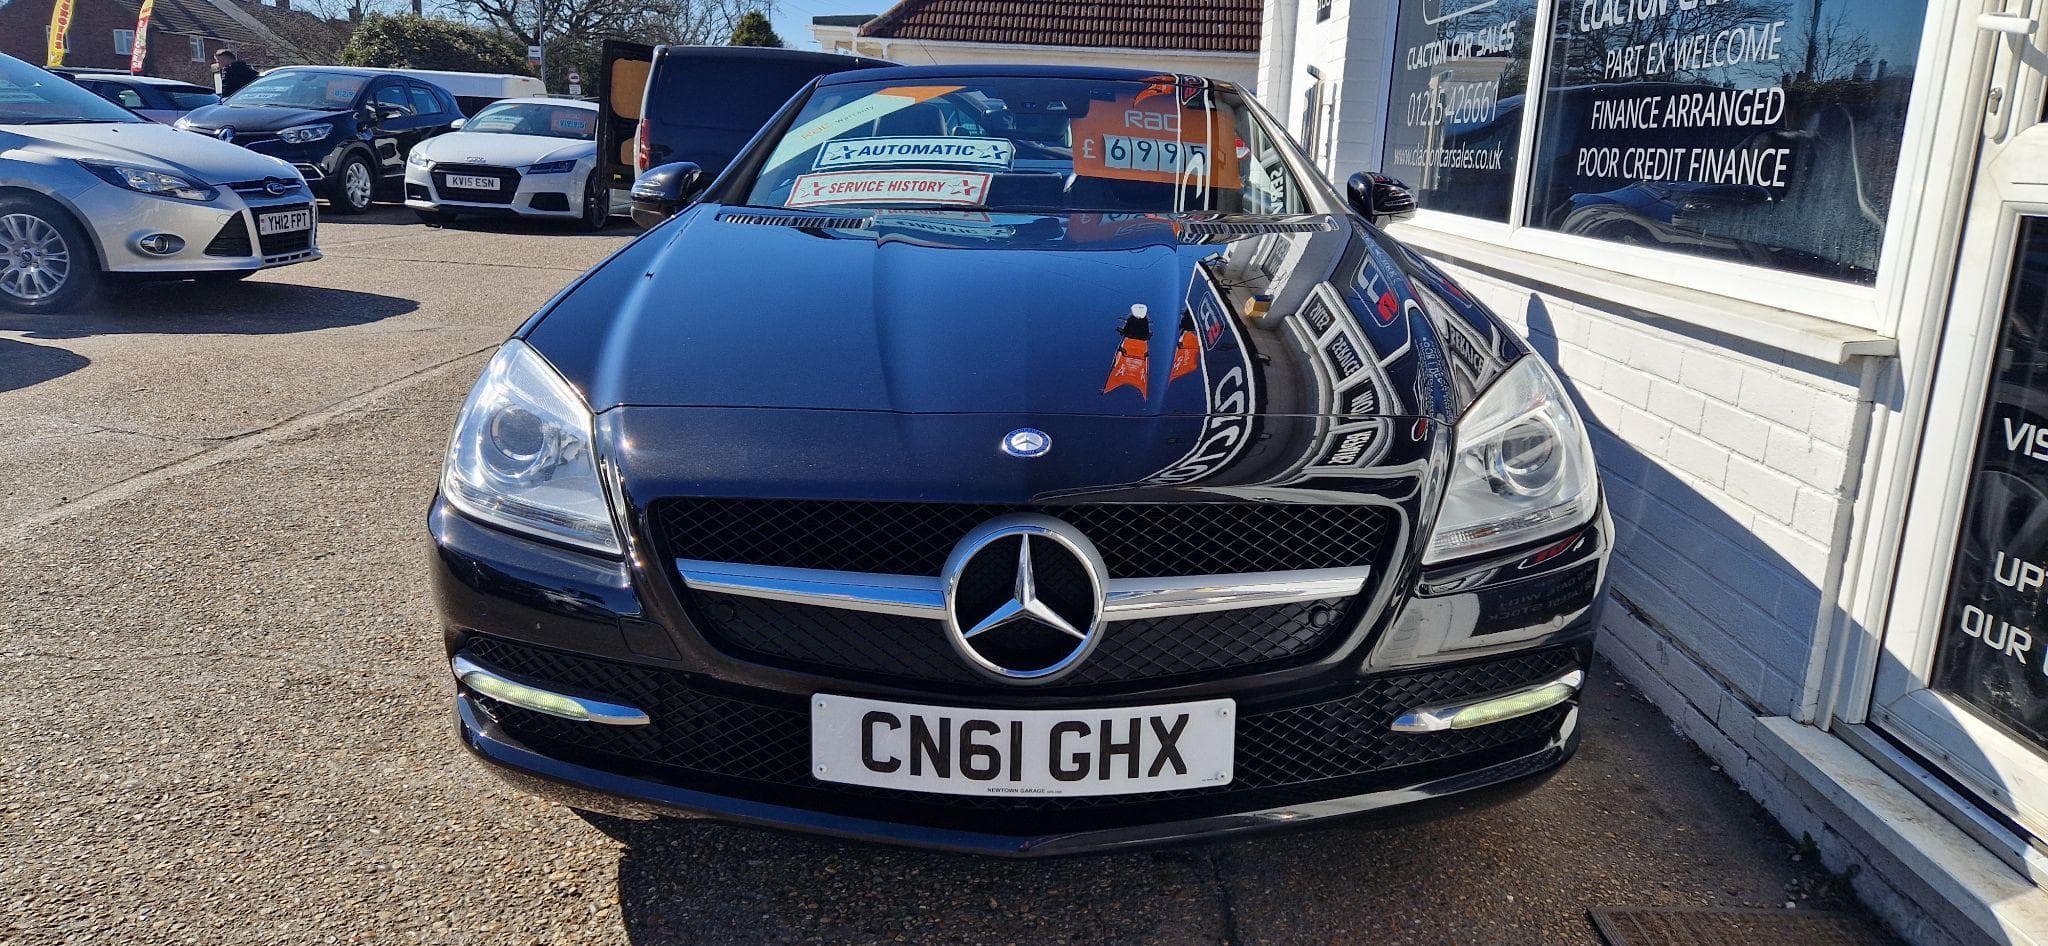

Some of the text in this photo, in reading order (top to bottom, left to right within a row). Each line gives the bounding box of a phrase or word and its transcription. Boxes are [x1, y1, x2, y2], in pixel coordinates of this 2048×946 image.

[1407, 20, 1517, 70] CLACTON CAR SALES
[1604, 20, 1785, 79] PART EX WELCOME
[1445, 77, 1499, 124] 426661
[1591, 87, 1785, 130] FINANCE ARRANGED
[857, 144, 976, 157] AUTOMATIC
[1082, 139, 1096, 159] £
[1577, 147, 1790, 188] POOR CREDIT FINANCE
[452, 176, 494, 188] KV15 ESN
[829, 180, 946, 194] SERVICE HISTORY
[268, 212, 307, 231] YH12 FPT
[1994, 551, 2048, 592] UP
[1961, 604, 2033, 665] OUR
[861, 710, 1190, 782] CN61 GHX
